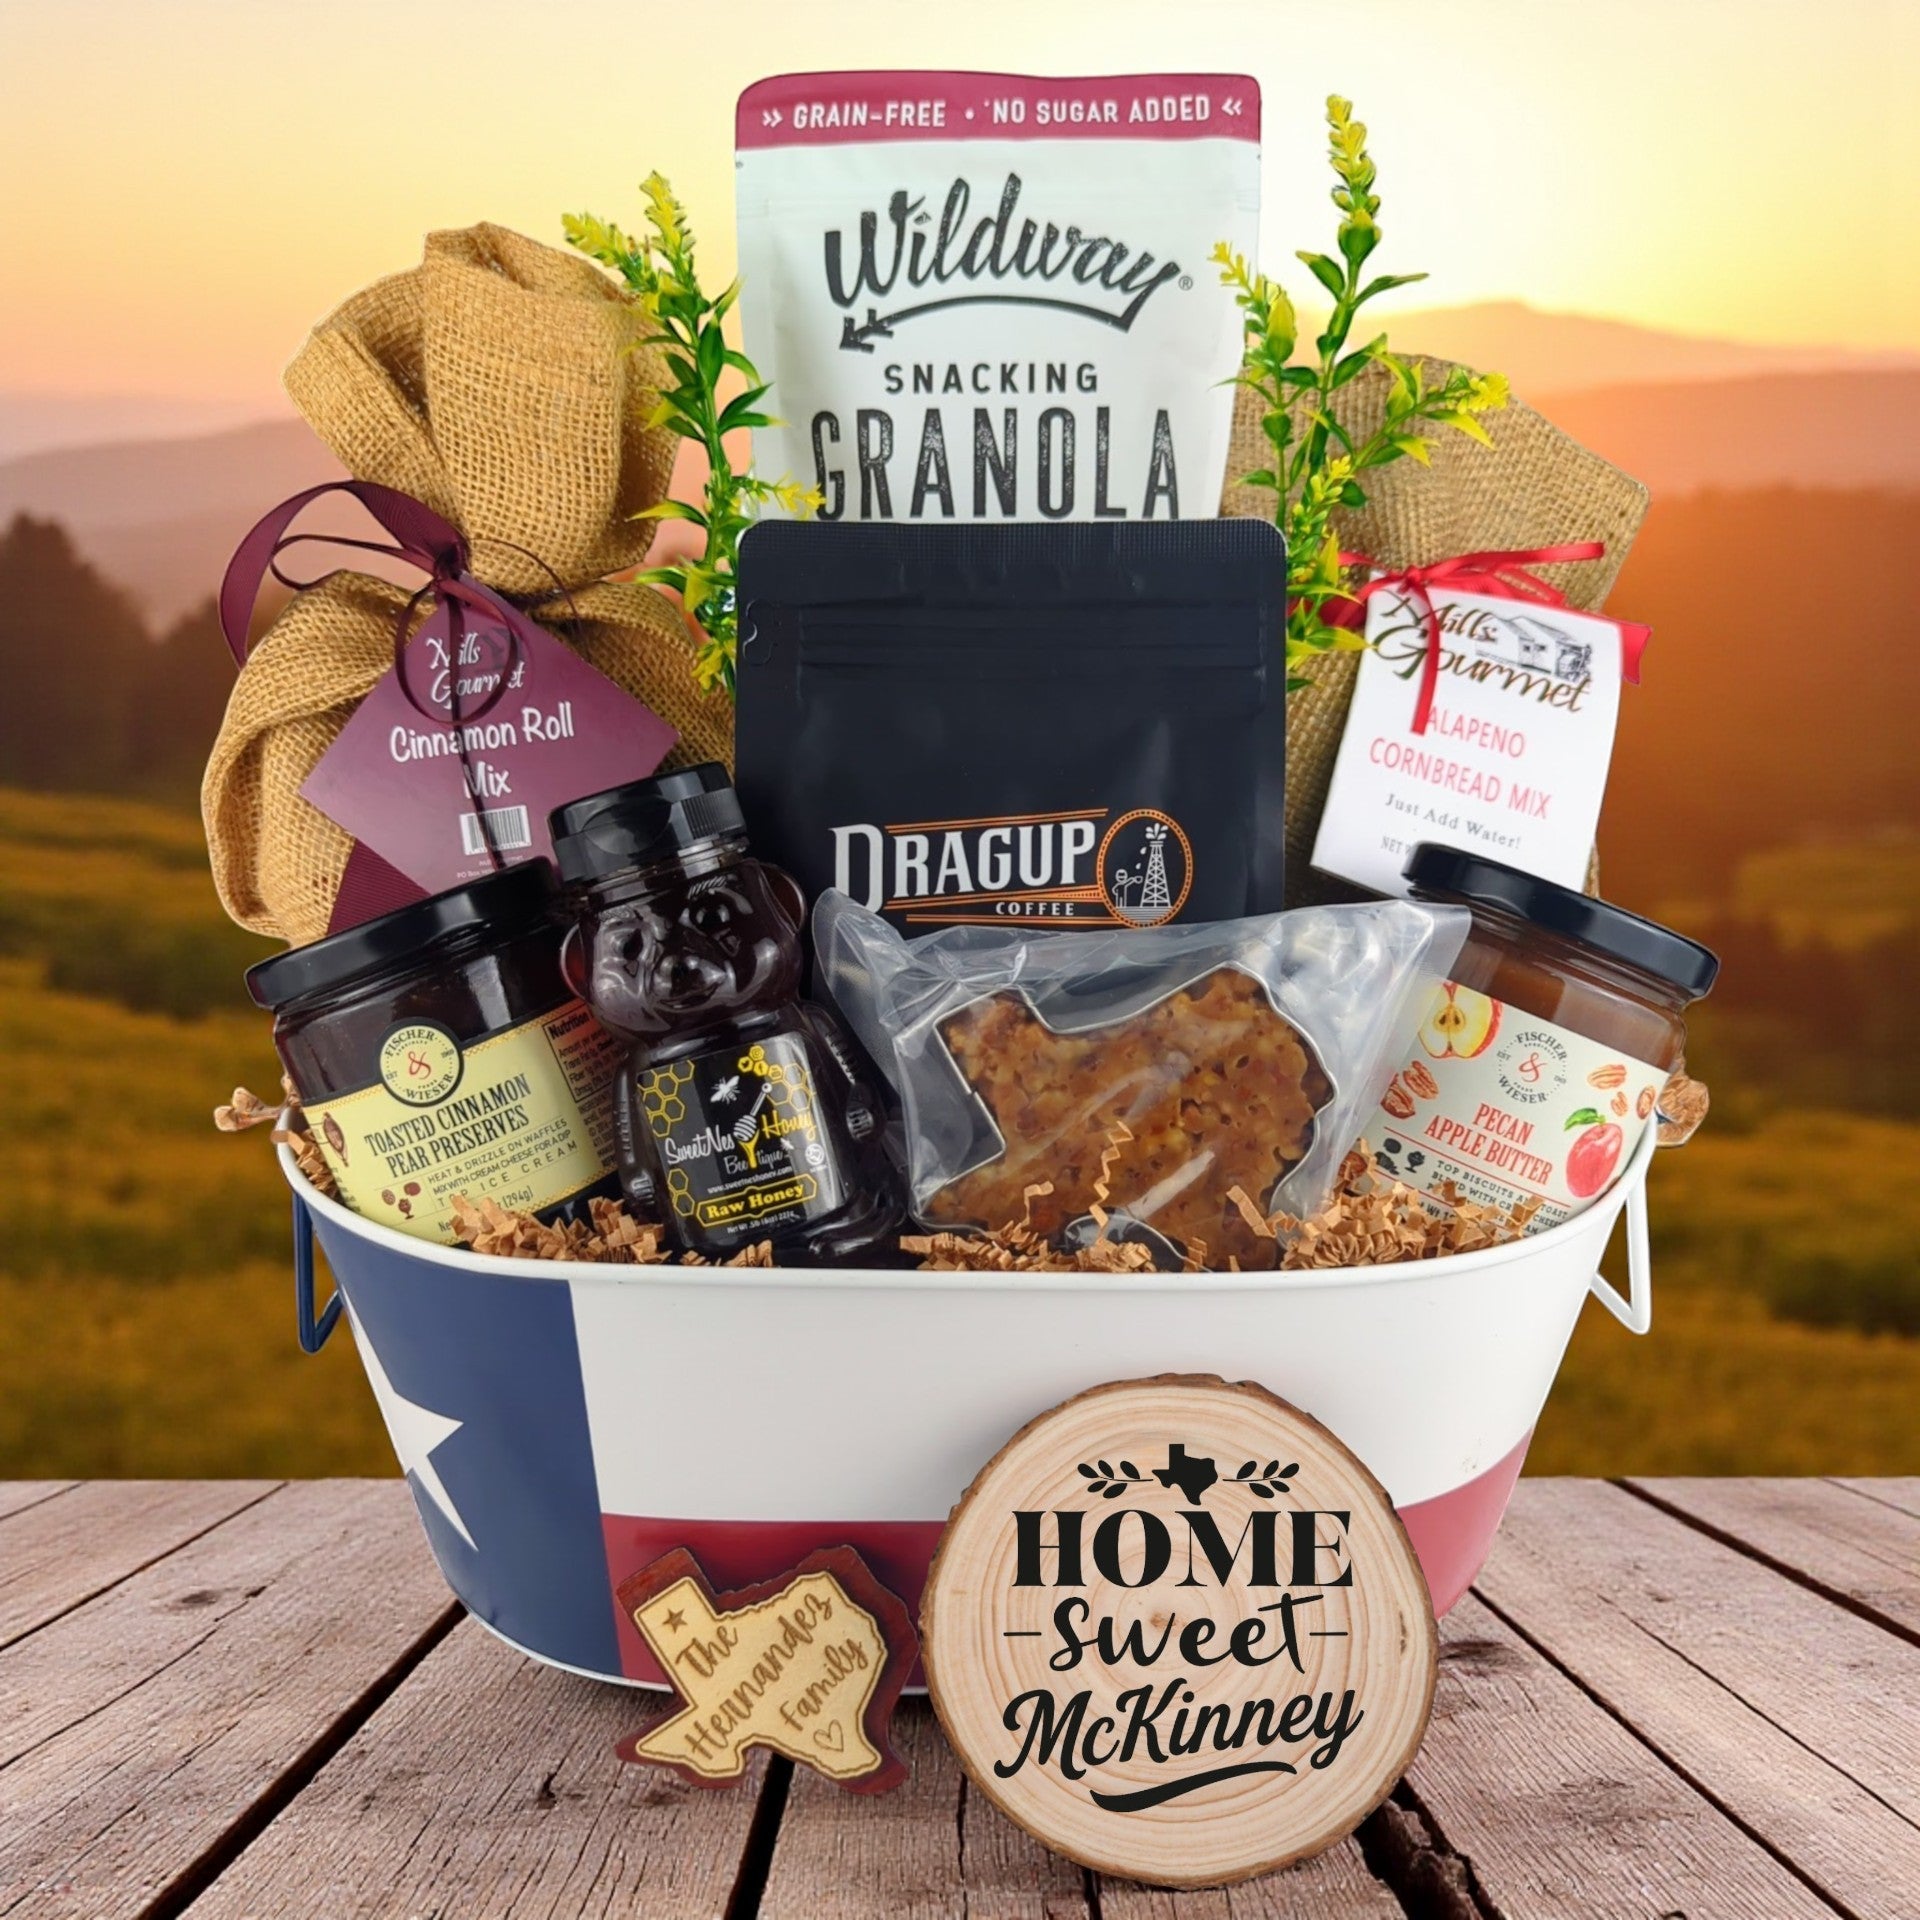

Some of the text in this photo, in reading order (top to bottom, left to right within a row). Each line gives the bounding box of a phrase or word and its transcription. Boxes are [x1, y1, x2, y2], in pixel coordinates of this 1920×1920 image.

[792, 94, 1211, 128] GRAIN-FREE NO SUGAR ADDED
[824, 172, 1182, 328] Wildway
[884, 362, 1098, 394] SNACKING
[811, 406, 1180, 521] GRANOLA
[1371, 624, 1592, 712] Gourmet
[389, 701, 576, 763] Cinnamon Roll
[1426, 707, 1526, 758] ALAPENO
[463, 760, 512, 801] Mix
[1369, 737, 1552, 819] CORNBREAD MIX
[1385, 793, 1522, 849] Just Add Water!
[828, 820, 1096, 915] DRAGUP
[995, 902, 1074, 916] COFFEE
[385, 1029, 435, 1057] FISCHER
[548, 1012, 591, 1040] Nutrition
[1516, 1031, 1568, 1061] FISCHER
[405, 1073, 454, 1100] WIESER
[408, 1051, 431, 1080] &
[1499, 1075, 1547, 1104] WIESER
[1519, 1052, 1548, 1082] &
[364, 1114, 436, 1157] TOASTED
[436, 1073, 532, 1131] CINNAMON
[762, 1109, 817, 1142] Honey
[1472, 1102, 1535, 1146] PECAN
[386, 1142, 430, 1178] PEAR
[433, 1104, 530, 1163] PRESERVES
[428, 1167, 454, 1183] HEAT
[464, 1147, 506, 1169] DRIZZLE
[507, 1139, 523, 1151] ON
[524, 1118, 567, 1144] WAFFLES
[470, 1163, 500, 1182] CREAM
[501, 1148, 534, 1168] CHEESE
[480, 1172, 510, 1191] ICE
[521, 1141, 578, 1173] CREAM
[1424, 1114, 1553, 1185] APPLE BUTTER
[706, 1183, 805, 1219] Raw Honey
[1432, 1171, 1466, 1191] BLD
[1469, 1187, 1497, 1205] WITH
[1437, 1160, 1460, 1176] TOP
[1463, 1171, 1513, 1199] BISCUITS
[1011, 1508, 1354, 1588] HOME
[675, 1624, 739, 1679] The
[684, 1592, 834, 1760] Hernandez
[779, 1637, 869, 1732] Family
[993, 1677, 1365, 1781] McKinney
